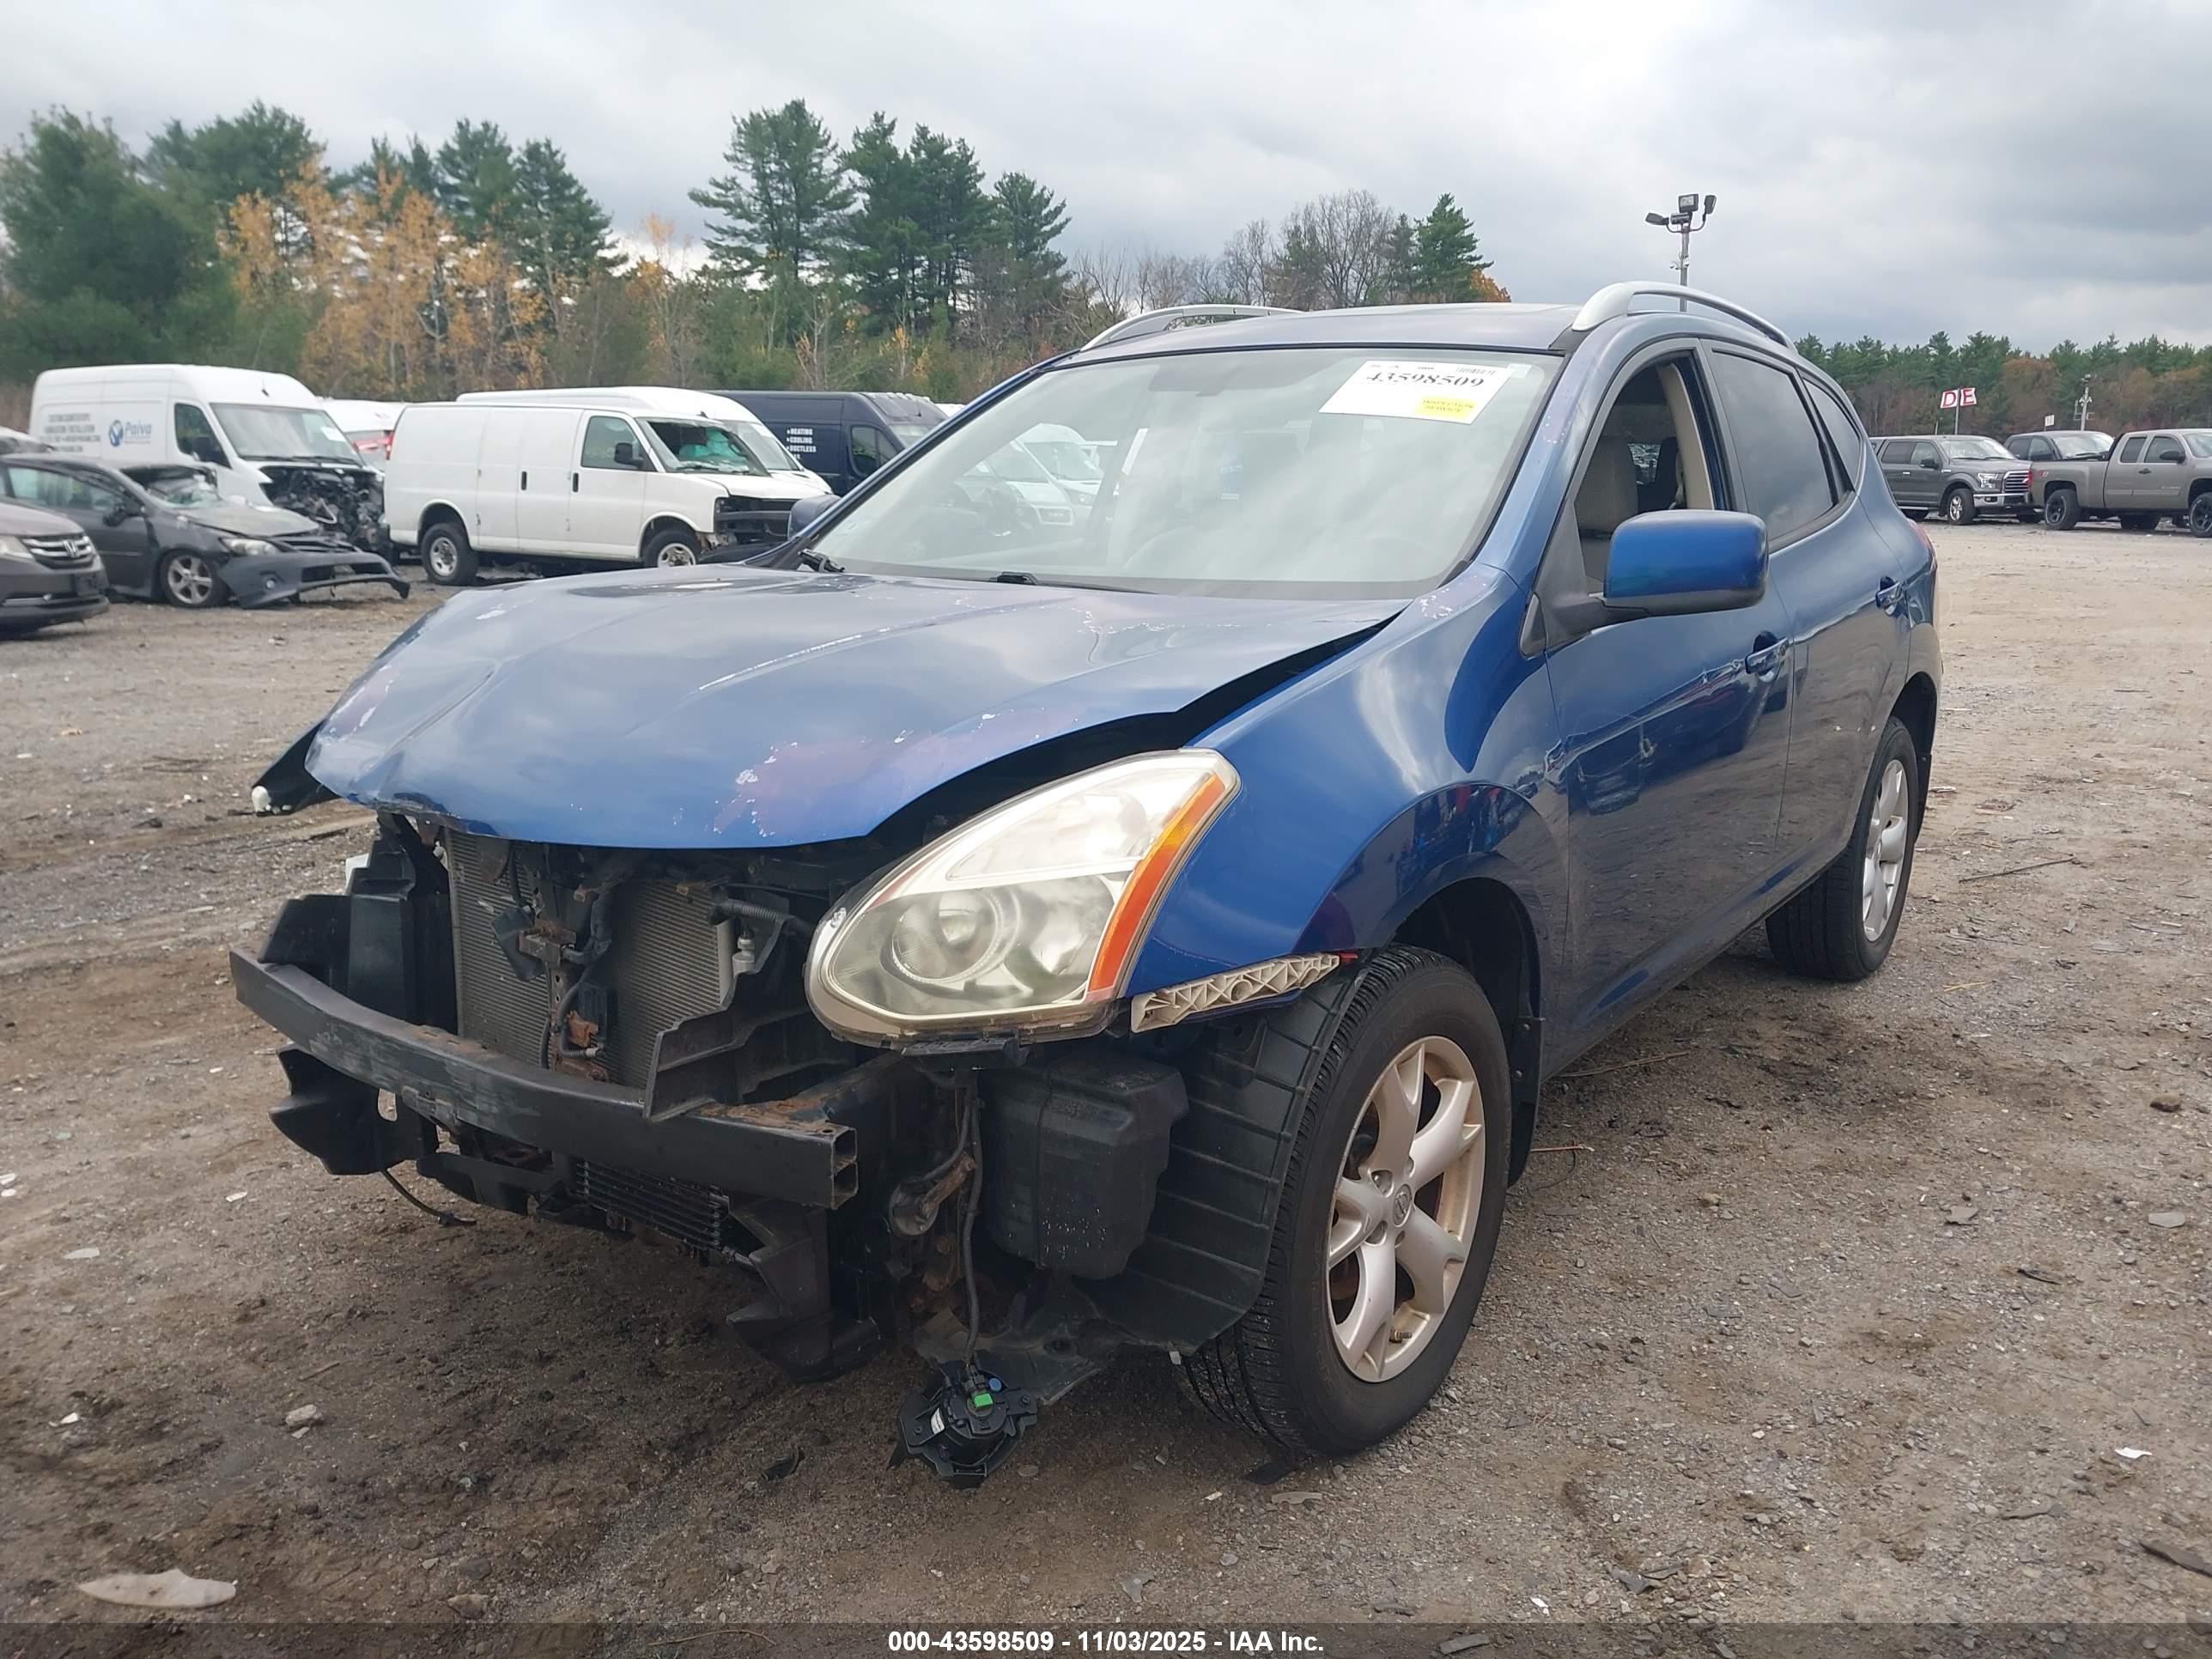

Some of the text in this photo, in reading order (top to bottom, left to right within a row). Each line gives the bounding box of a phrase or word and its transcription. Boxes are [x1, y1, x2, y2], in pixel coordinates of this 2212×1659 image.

[1366, 372, 1485, 386] 43598509
[1942, 392, 1957, 407] D
[1963, 389, 1975, 404] E
